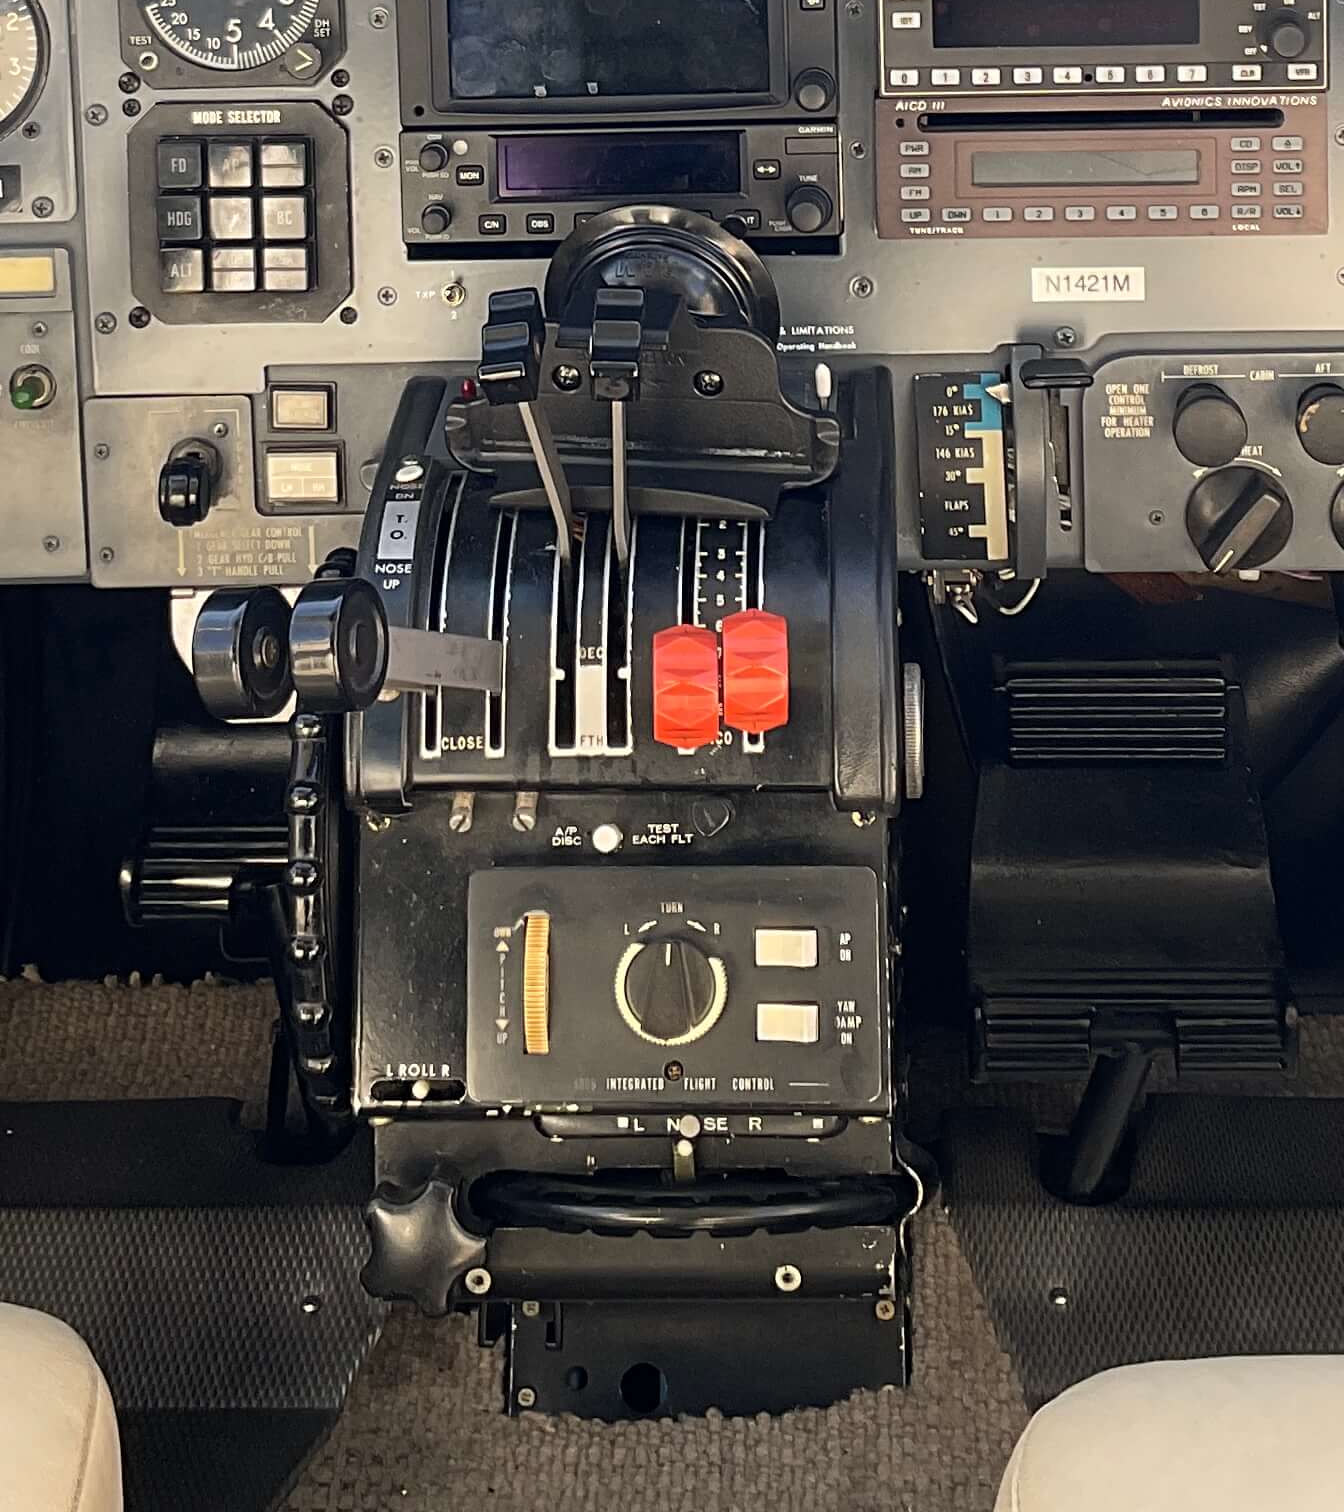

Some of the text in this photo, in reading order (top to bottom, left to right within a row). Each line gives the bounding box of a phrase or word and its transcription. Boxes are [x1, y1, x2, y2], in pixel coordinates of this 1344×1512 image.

[896, 100, 926, 111] AICD
[1162, 95, 1318, 108] AVIONICS INNOVATIONS
[192, 109, 281, 124] MODE SELECTOR
[171, 157, 187, 174] FD
[167, 209, 192, 226] HDG
[1045, 274, 1131, 294] N1421M
[792, 326, 854, 335] LIMITATIONS
[1183, 364, 1219, 375] DEFROST
[1105, 384, 1150, 394] OPEN ONE
[1109, 395, 1145, 405] CONTROL
[1101, 416, 1153, 427] FOR HEATER
[1104, 427, 1150, 438] OPERATION
[936, 448, 975, 459] 146 KIAS
[945, 500, 969, 511] FLAPS
[374, 563, 412, 575] NOSE
[383, 578, 400, 590] UP
[440, 736, 484, 750] CLOSE
[607, 1077, 774, 1091] INTEGRATED FLIGHT CONTROL
